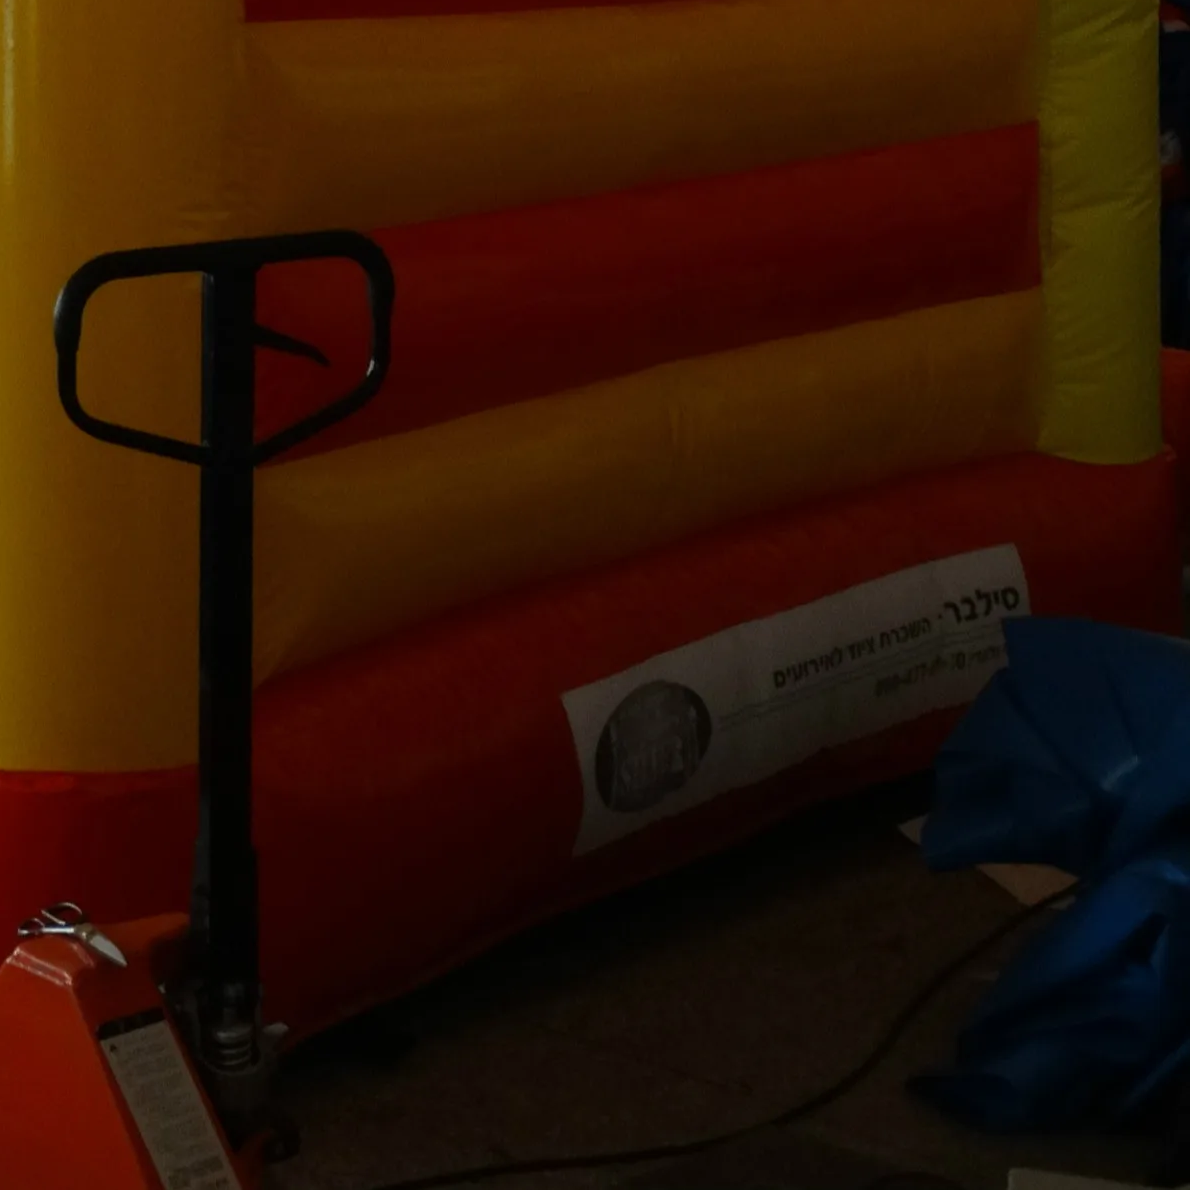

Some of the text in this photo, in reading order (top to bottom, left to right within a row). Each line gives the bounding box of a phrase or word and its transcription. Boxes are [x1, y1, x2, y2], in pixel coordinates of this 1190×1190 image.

[846, 637, 876, 661] ציוד
[880, 618, 931, 649] השכרת
[773, 645, 843, 688] לאירועים
